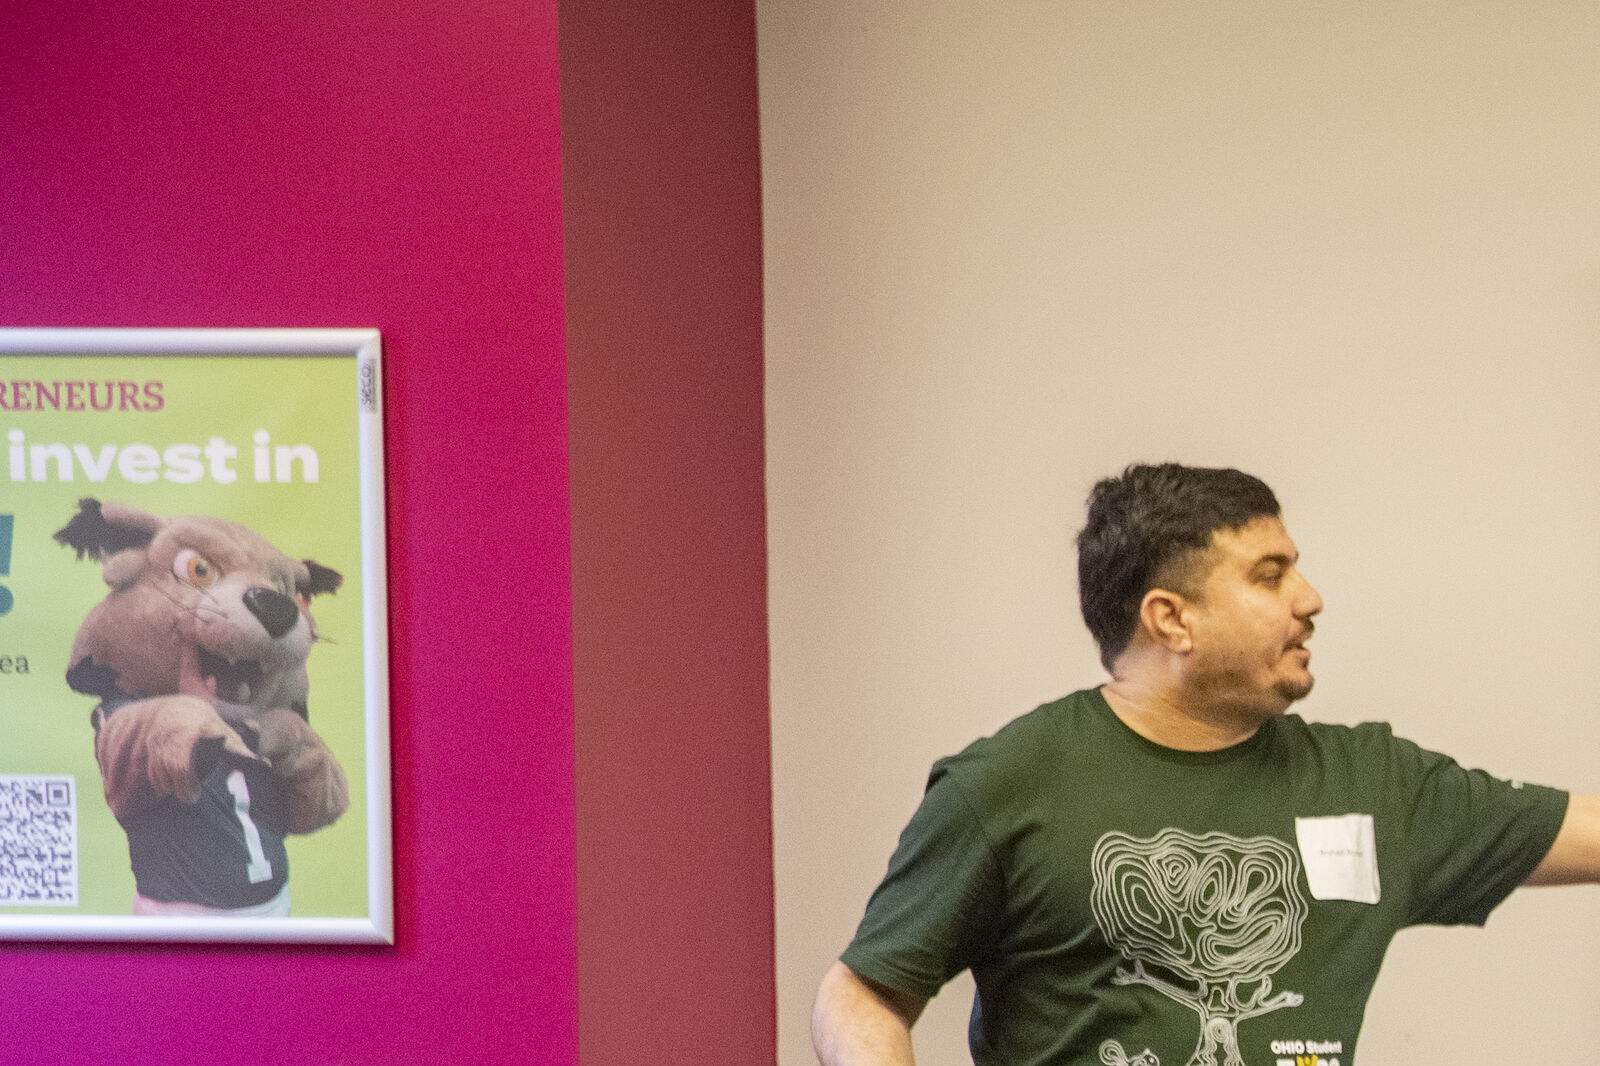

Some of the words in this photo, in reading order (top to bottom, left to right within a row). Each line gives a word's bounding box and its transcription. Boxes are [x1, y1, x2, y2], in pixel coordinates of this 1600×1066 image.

[7, 427, 238, 485] invest
[252, 428, 320, 484] in
[1271, 1040, 1305, 1054] OHIO
